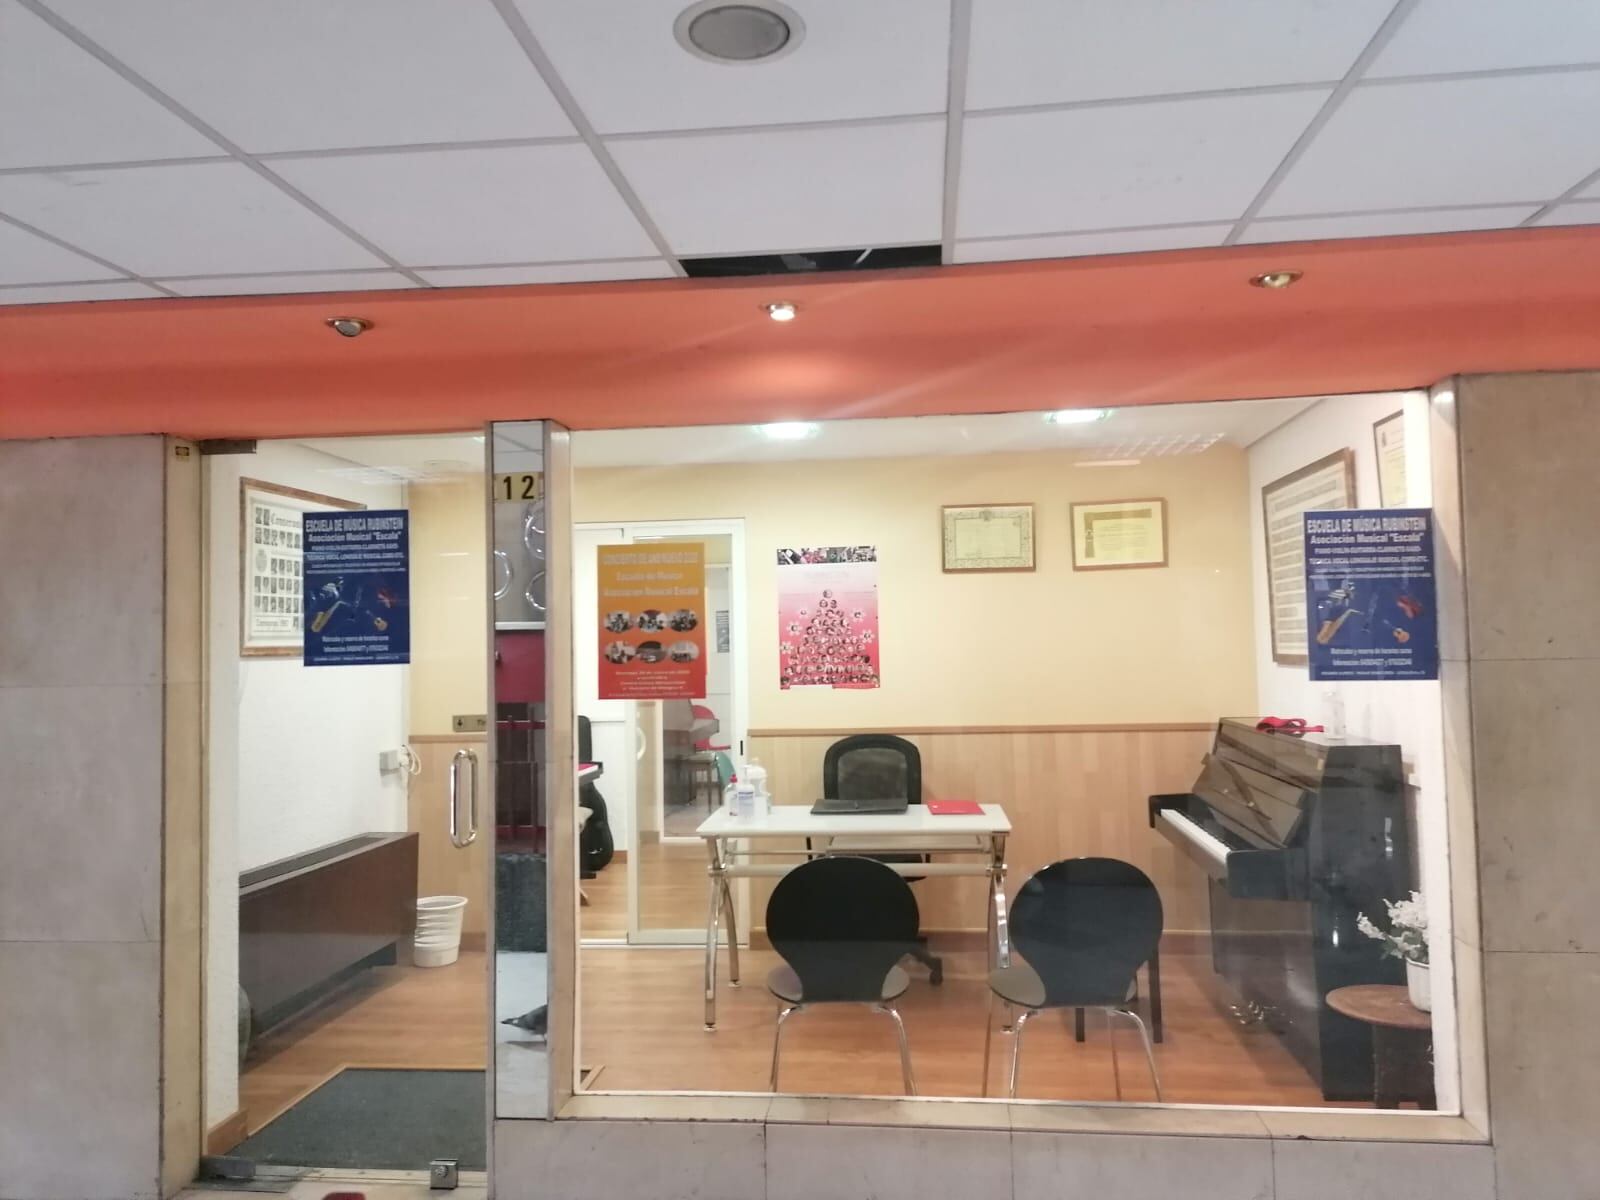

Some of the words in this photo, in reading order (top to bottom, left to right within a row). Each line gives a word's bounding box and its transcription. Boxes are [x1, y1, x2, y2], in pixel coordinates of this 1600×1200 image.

[503, 475, 534, 500] 12
[305, 519, 334, 533] ESCUELA
[334, 518, 343, 532] DE
[1307, 519, 1341, 534] ESCUELA
[1341, 518, 1352, 533] DE
[1353, 515, 1382, 532] MÚSICA
[346, 532, 372, 541] Musical
[1310, 534, 1356, 544] Asociación
[1356, 533, 1388, 543] Musical
[1389, 532, 1425, 542] "Escala"
